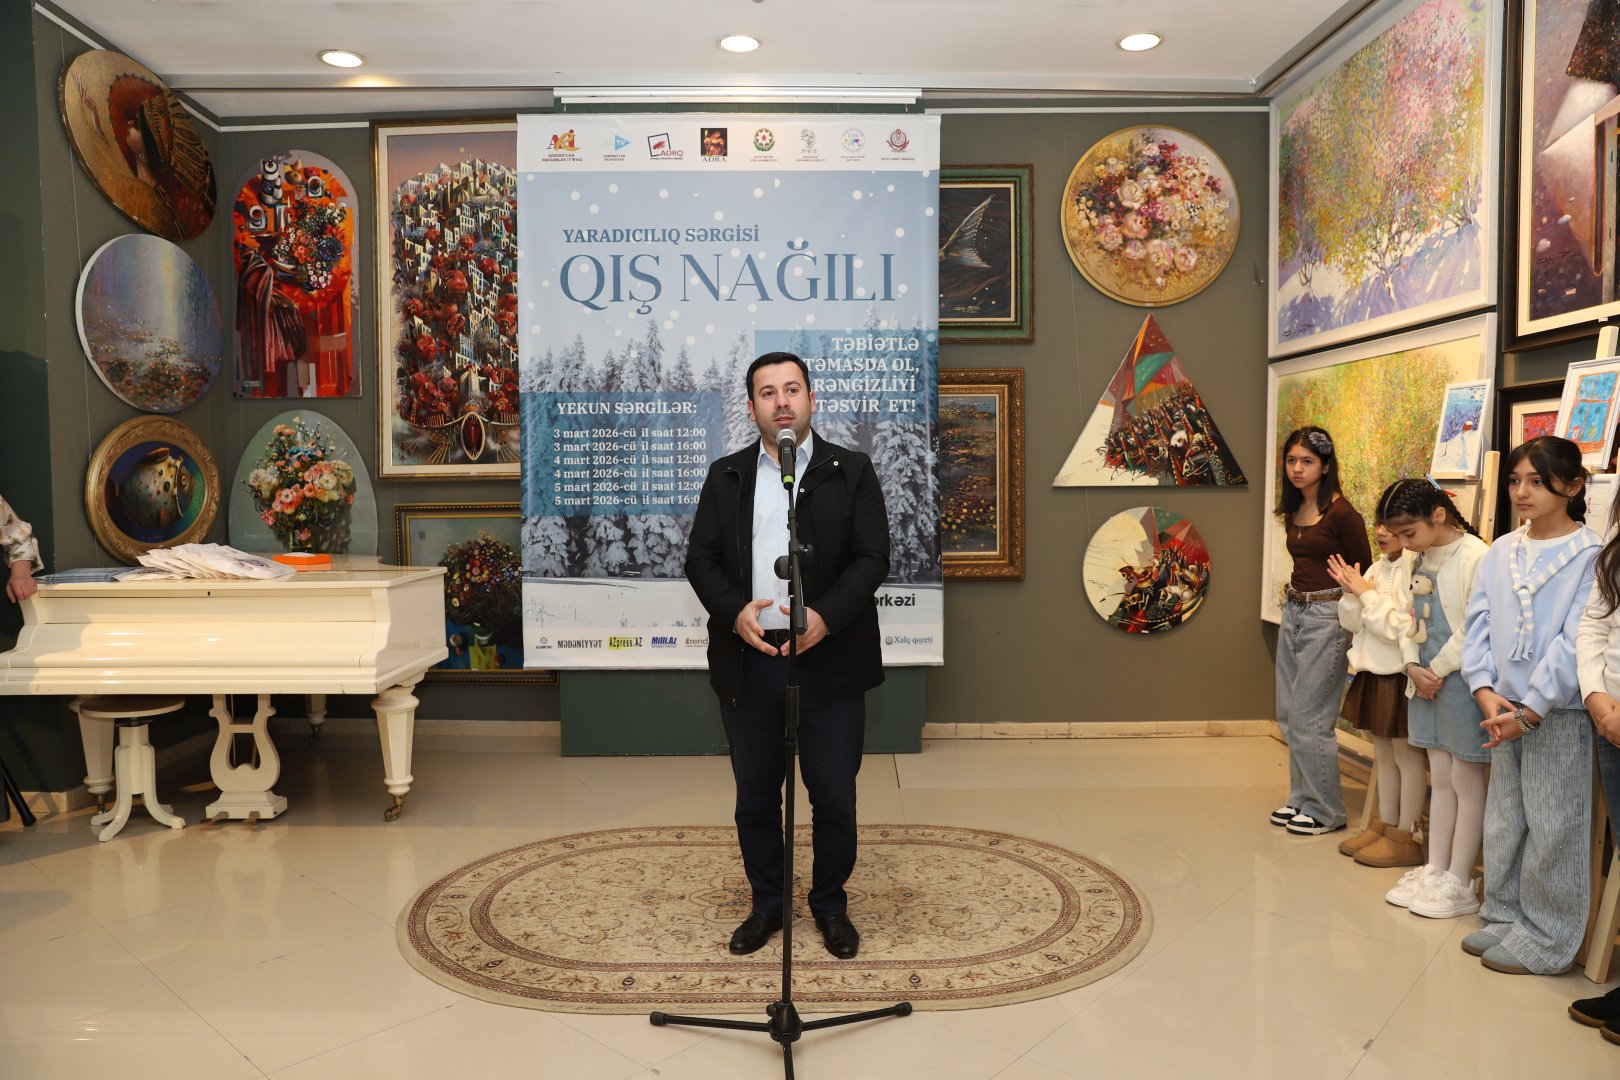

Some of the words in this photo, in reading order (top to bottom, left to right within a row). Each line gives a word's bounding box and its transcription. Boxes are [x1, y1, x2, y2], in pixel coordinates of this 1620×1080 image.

[660, 149, 684, 157] ADRQ
[563, 228, 681, 245] YARADICILIQ
[685, 224, 760, 243] SƏRGİSİ
[559, 254, 662, 315] QIŞ
[680, 240, 897, 302] NAĞILI
[832, 334, 919, 351] TƏBİƏTLƏ
[804, 358, 887, 372] TƏMASDA
[891, 358, 920, 374] OL,
[811, 375, 916, 392] RƏNGİZLİYİ
[557, 402, 610, 415] YEKUN
[614, 399, 697, 415] SƏRGİLƏR:
[816, 396, 880, 413] TƏSVİR
[888, 399, 916, 413] ET!
[554, 429, 560, 438] 3
[563, 430, 590, 438] mart
[592, 428, 636, 438] 2026-cü
[641, 428, 649, 438] il
[652, 429, 674, 438] saat
[676, 428, 706, 437] 12:00
[554, 442, 560, 451] 3
[563, 443, 590, 451] mart
[592, 442, 636, 451] 2026-cü
[641, 441, 649, 451] il
[652, 442, 674, 451] saat
[677, 441, 706, 450] 16:00
[554, 456, 560, 465] 4
[563, 456, 590, 465] mart
[592, 455, 636, 465] 2026-cü
[641, 455, 649, 464] il
[652, 456, 674, 464] saat
[677, 455, 707, 464] 12:00
[554, 469, 561, 478] 4
[564, 470, 590, 478] mart
[593, 469, 637, 478] 2026-cü
[642, 468, 650, 478] il
[652, 469, 674, 478] saat
[677, 468, 706, 477] 16:00
[554, 483, 561, 492] 5
[564, 483, 590, 492] mart
[593, 482, 637, 492] 2026-cü
[642, 482, 650, 491] il
[653, 483, 674, 491] saat
[555, 496, 561, 505] 5
[564, 496, 590, 505] mart
[593, 496, 637, 505] 2026-cü
[642, 495, 650, 504] il
[653, 496, 675, 504] saat
[678, 495, 699, 504] 16:0
[874, 593, 916, 607] ərkəzi
[557, 639, 602, 649] MƏDƏNİYYƏT
[608, 636, 643, 650] AZpress.AZ
[651, 636, 678, 645] Milli.Az
[894, 636, 911, 644] Xalq
